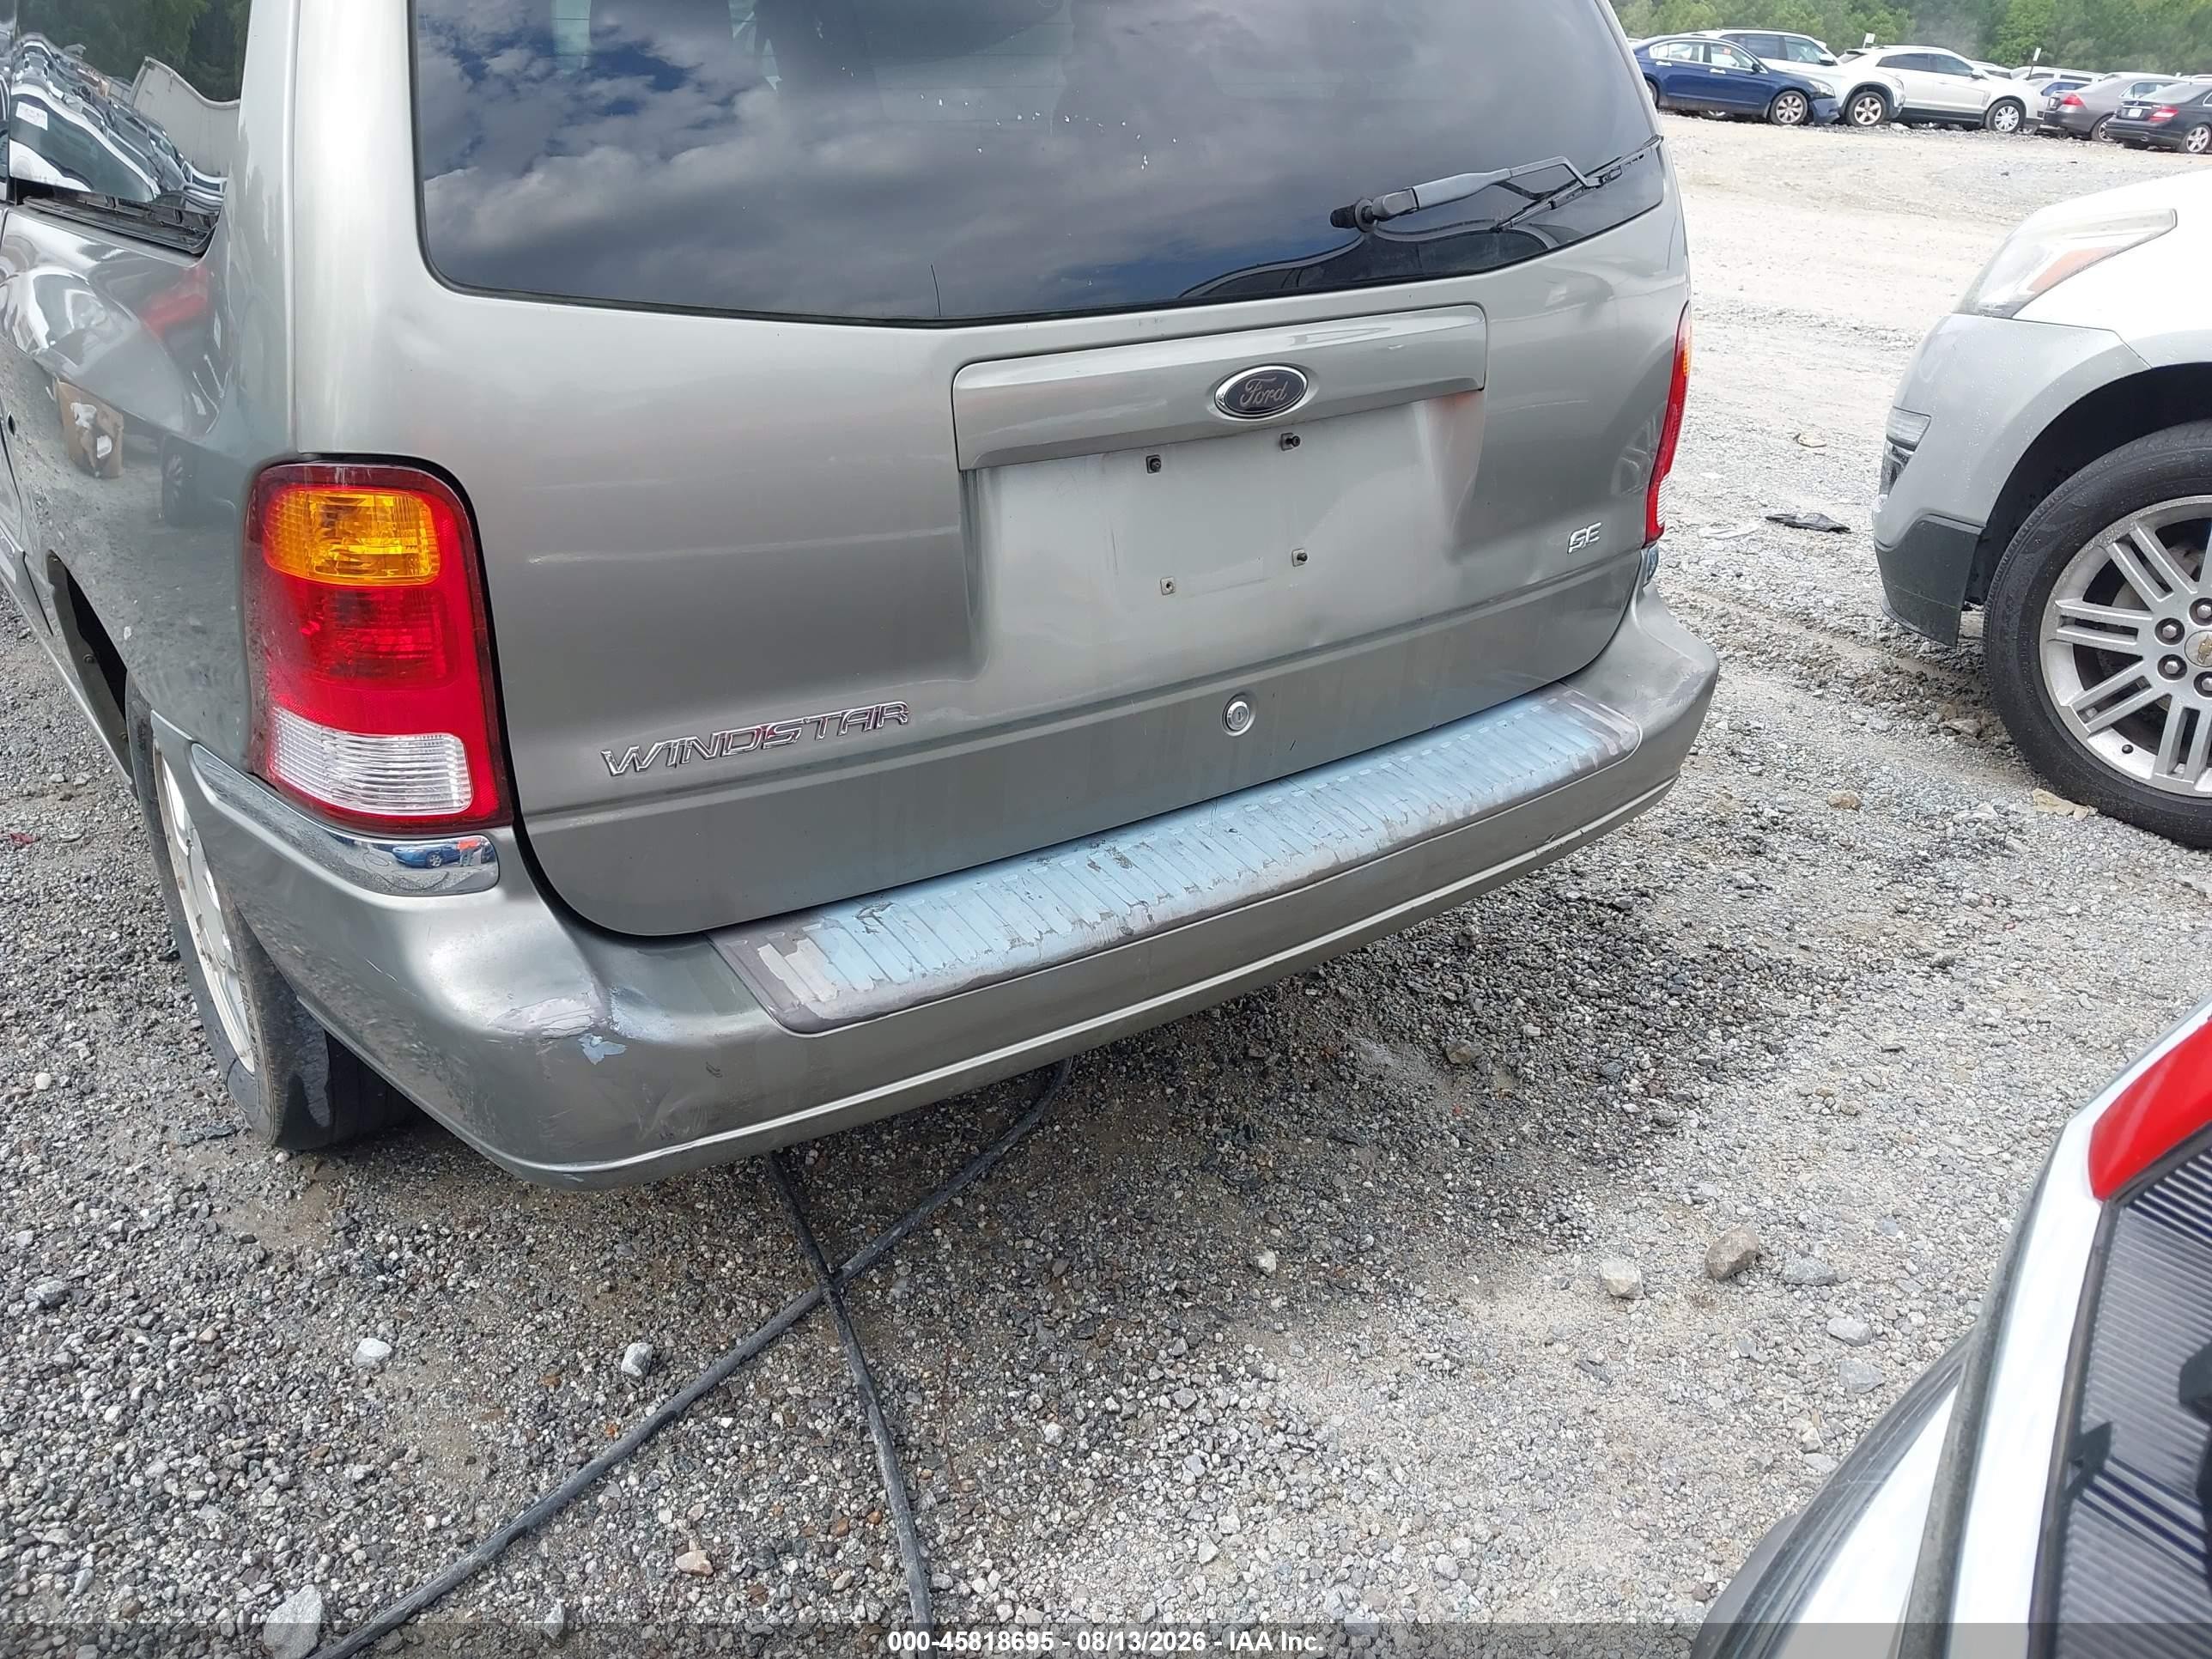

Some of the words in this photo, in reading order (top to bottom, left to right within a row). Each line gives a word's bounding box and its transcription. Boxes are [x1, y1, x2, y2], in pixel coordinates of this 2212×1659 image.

[1239, 376, 1289, 408] Ford
[1567, 522, 1601, 554] SE
[601, 701, 909, 776] WINDSTAR
